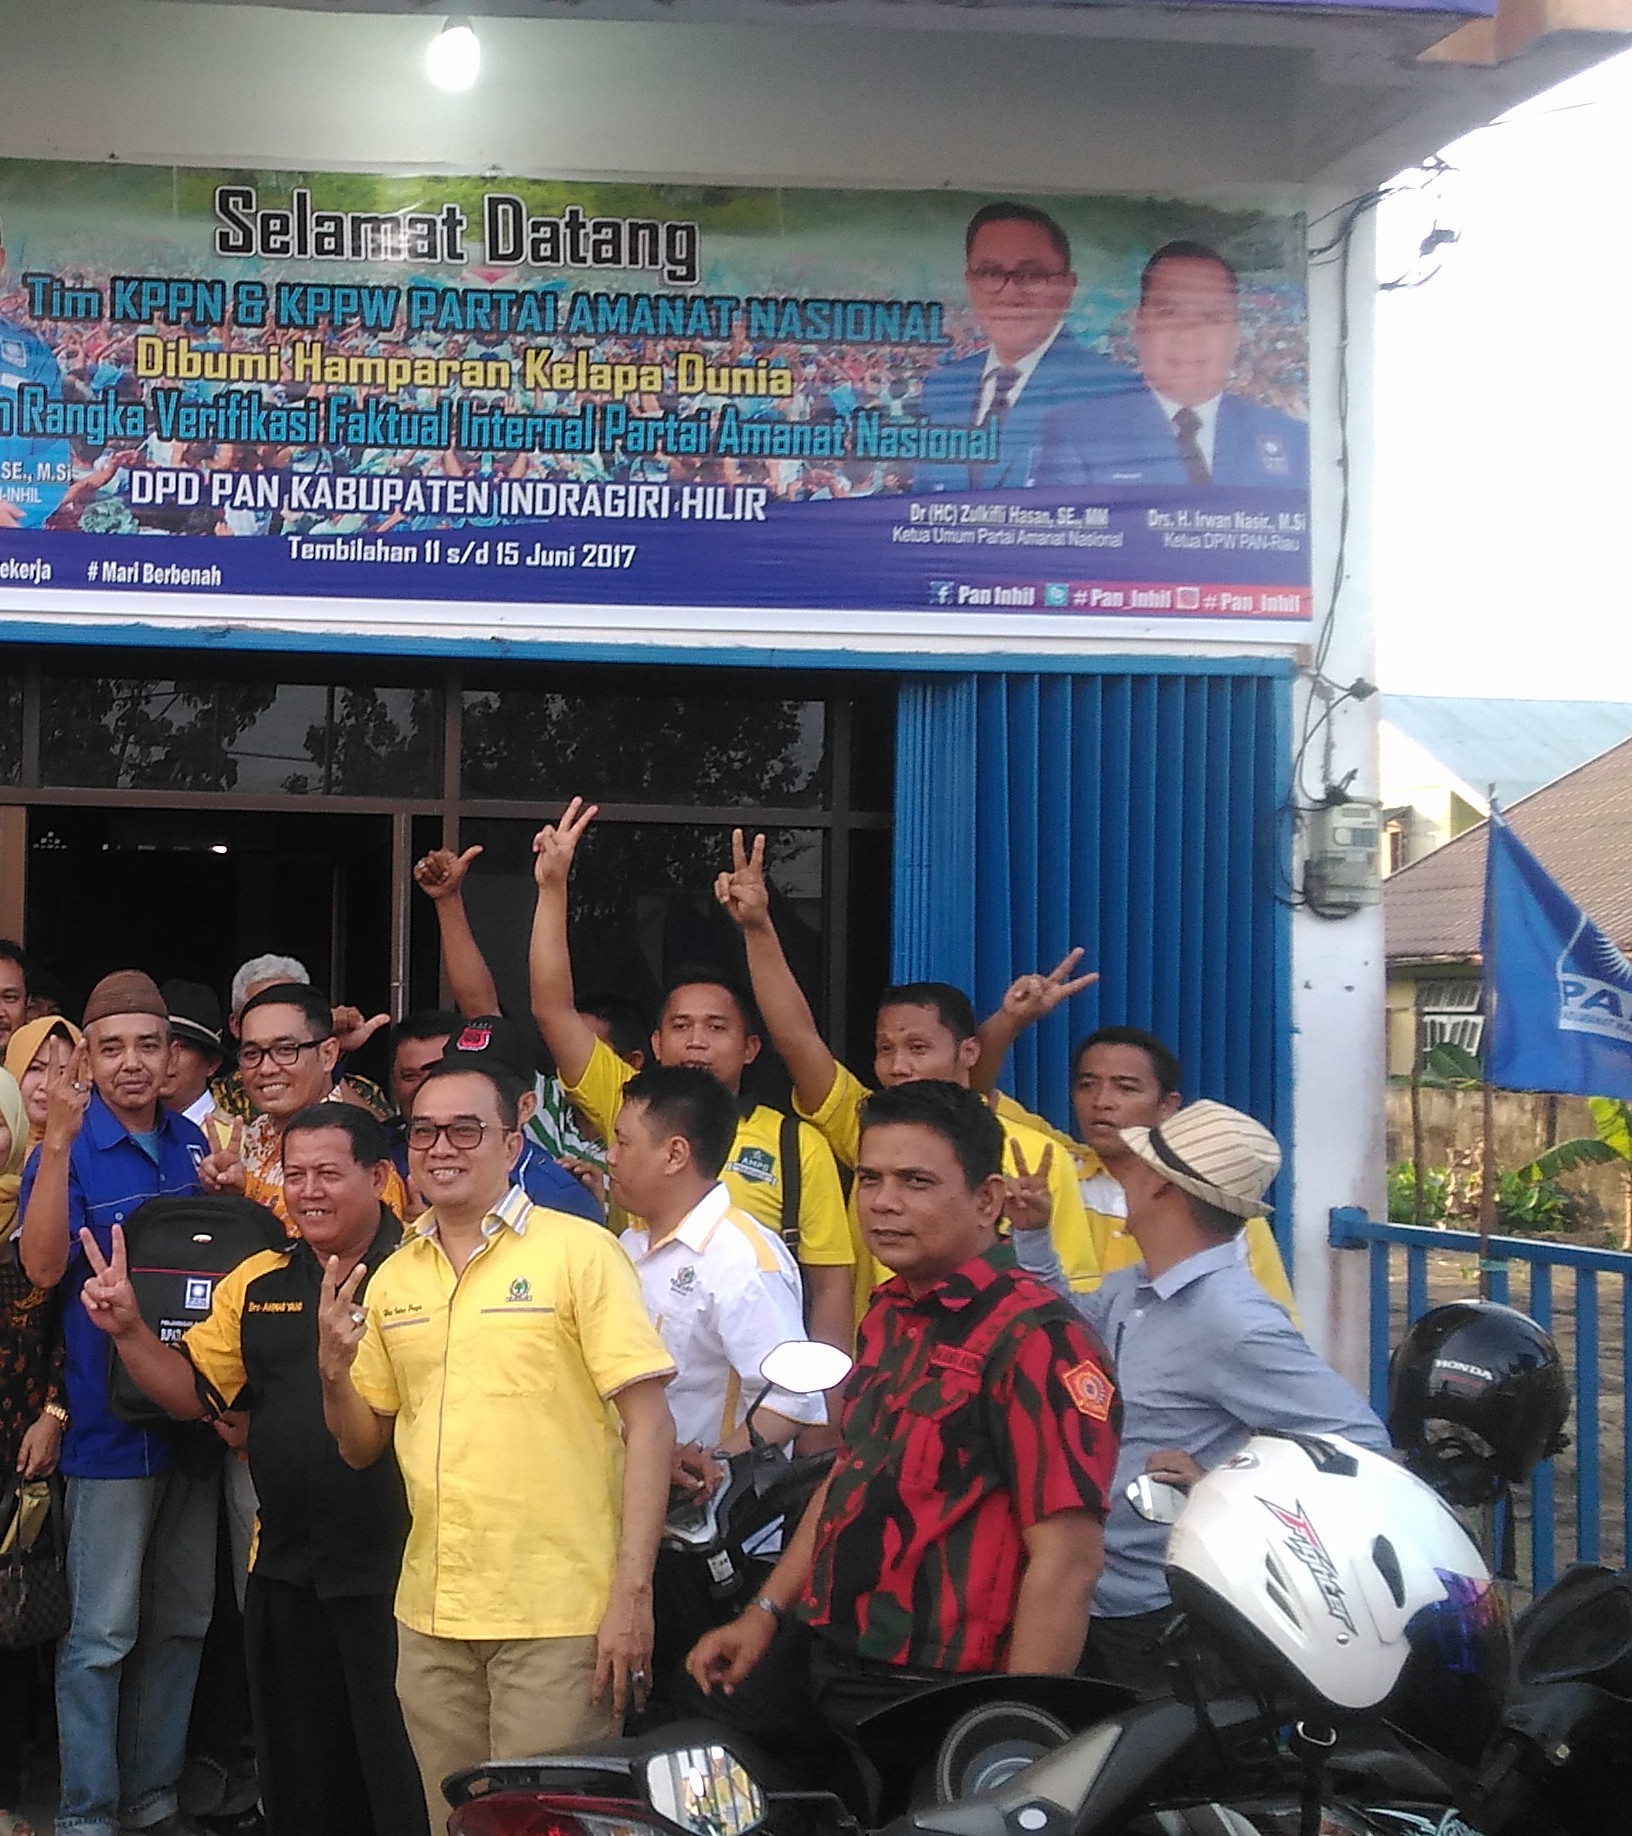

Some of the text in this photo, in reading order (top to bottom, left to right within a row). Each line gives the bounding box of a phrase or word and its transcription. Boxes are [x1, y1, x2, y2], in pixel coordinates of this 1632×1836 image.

[214, 185, 701, 285] Selamat Datang
[26, 274, 950, 347] Tim KPPN & KPPW PARTAI AMANAT NASIONAL
[137, 336, 795, 399] Dibumi Hamparan Kelapa Dunia
[22, 384, 145, 446] Rangka
[154, 390, 317, 443] Verifikasi
[327, 398, 450, 449] Faktual
[460, 401, 593, 453] Internal
[603, 404, 709, 456] Partai
[719, 411, 846, 460] Amanat
[856, 415, 1001, 463] Nasional
[131, 470, 768, 522] DPD PAN KABUPATEN INDRAGIRI HILIR
[910, 503, 927, 522] Dr
[928, 503, 958, 526] (HC)
[288, 536, 636, 568] Tembilahan 11 s/d 15 Juni 2017
[893, 526, 1124, 548] Ketua Umum Partai Amanat Nasional
[1164, 533, 1202, 548] Ketua
[102, 561, 139, 583] Mari
[143, 562, 222, 587] Berbenah
[1433, 1358, 1494, 1381] HONDA
